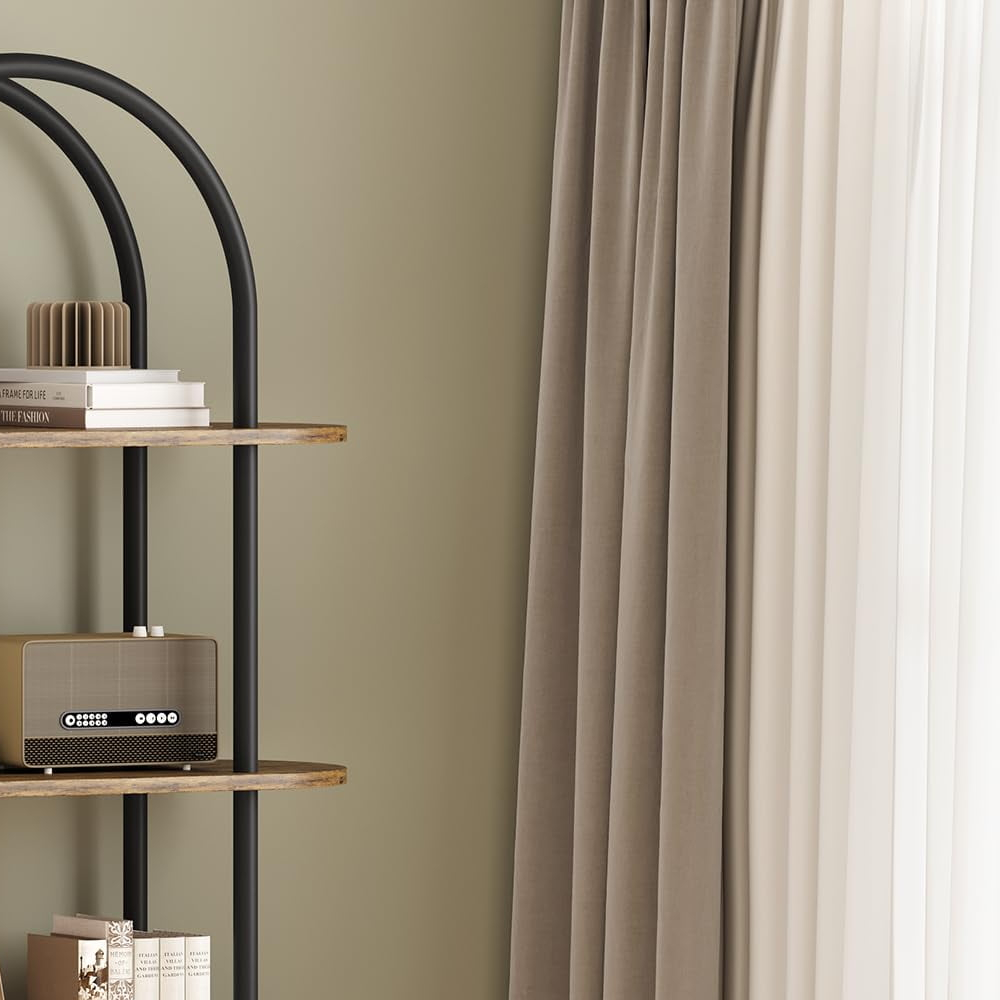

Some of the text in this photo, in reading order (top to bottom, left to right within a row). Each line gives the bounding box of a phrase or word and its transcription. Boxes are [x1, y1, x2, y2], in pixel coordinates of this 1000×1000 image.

[2, 388, 22, 400] FRAME
[22, 389, 34, 400] FOR
[34, 389, 47, 400] LIFE
[0, 409, 50, 423] THE FASHION
